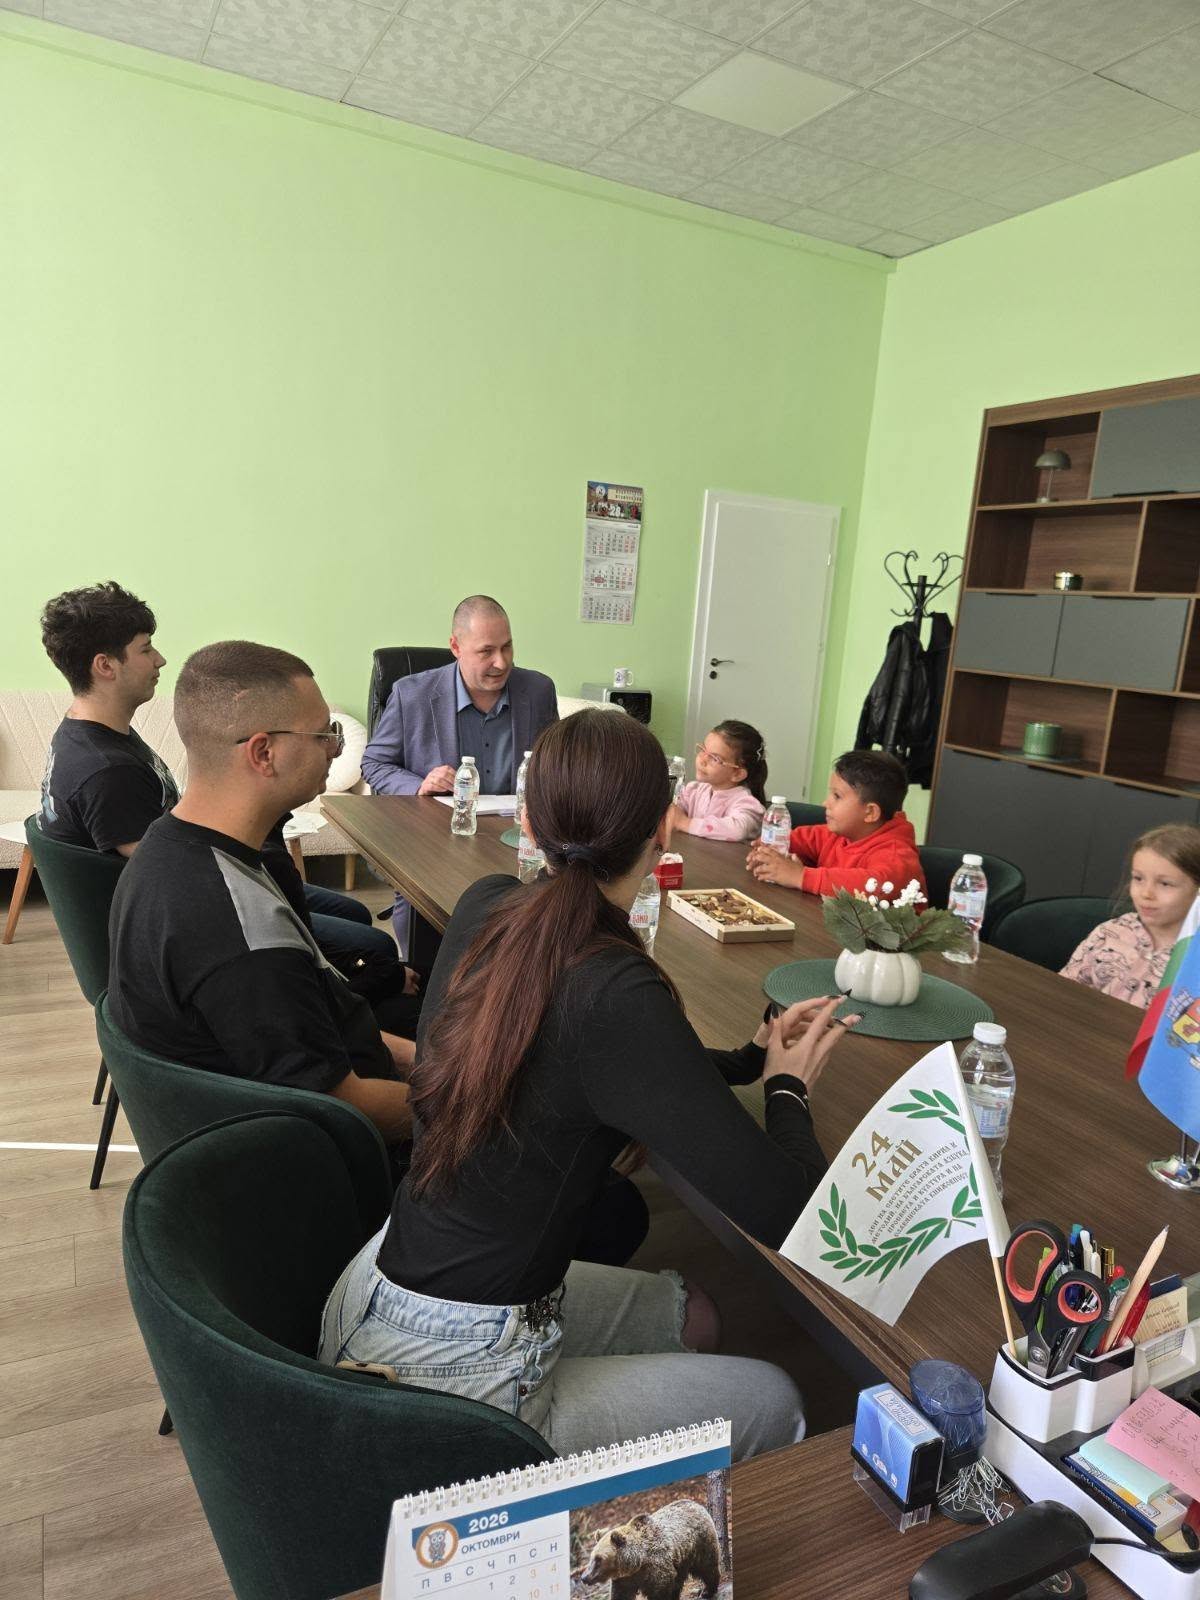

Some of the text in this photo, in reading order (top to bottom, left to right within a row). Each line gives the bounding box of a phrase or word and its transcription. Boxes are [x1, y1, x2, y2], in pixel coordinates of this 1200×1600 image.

[852, 1130, 893, 1178] 24
[866, 1140, 923, 1202] МАЙ
[868, 1218, 878, 1235] ДЕН
[878, 1209, 887, 1221] НА
[886, 1180, 910, 1209] СВЕТИТЕ
[909, 1161, 929, 1179] БРАТЯ
[930, 1146, 952, 1163] КИРИЛ
[887, 1202, 914, 1233] ПРОСВЕТА
[913, 1195, 920, 1203] И
[919, 1172, 946, 1196] КУЛТУРА
[953, 1164, 962, 1172] НА
[896, 1199, 904, 1209] НА
[904, 1162, 943, 1200] БЪЛГАРСКАТА
[461, 1531, 520, 1554] ОКТОМВРИ
[469, 1511, 509, 1533] 2026
[422, 1543, 557, 1588] П В С Ч П С Н
[510, 1576, 515, 1584] 2
[530, 1569, 536, 1578] 3
[551, 1563, 557, 1572] 4
[529, 1584, 560, 1598] 10 11
